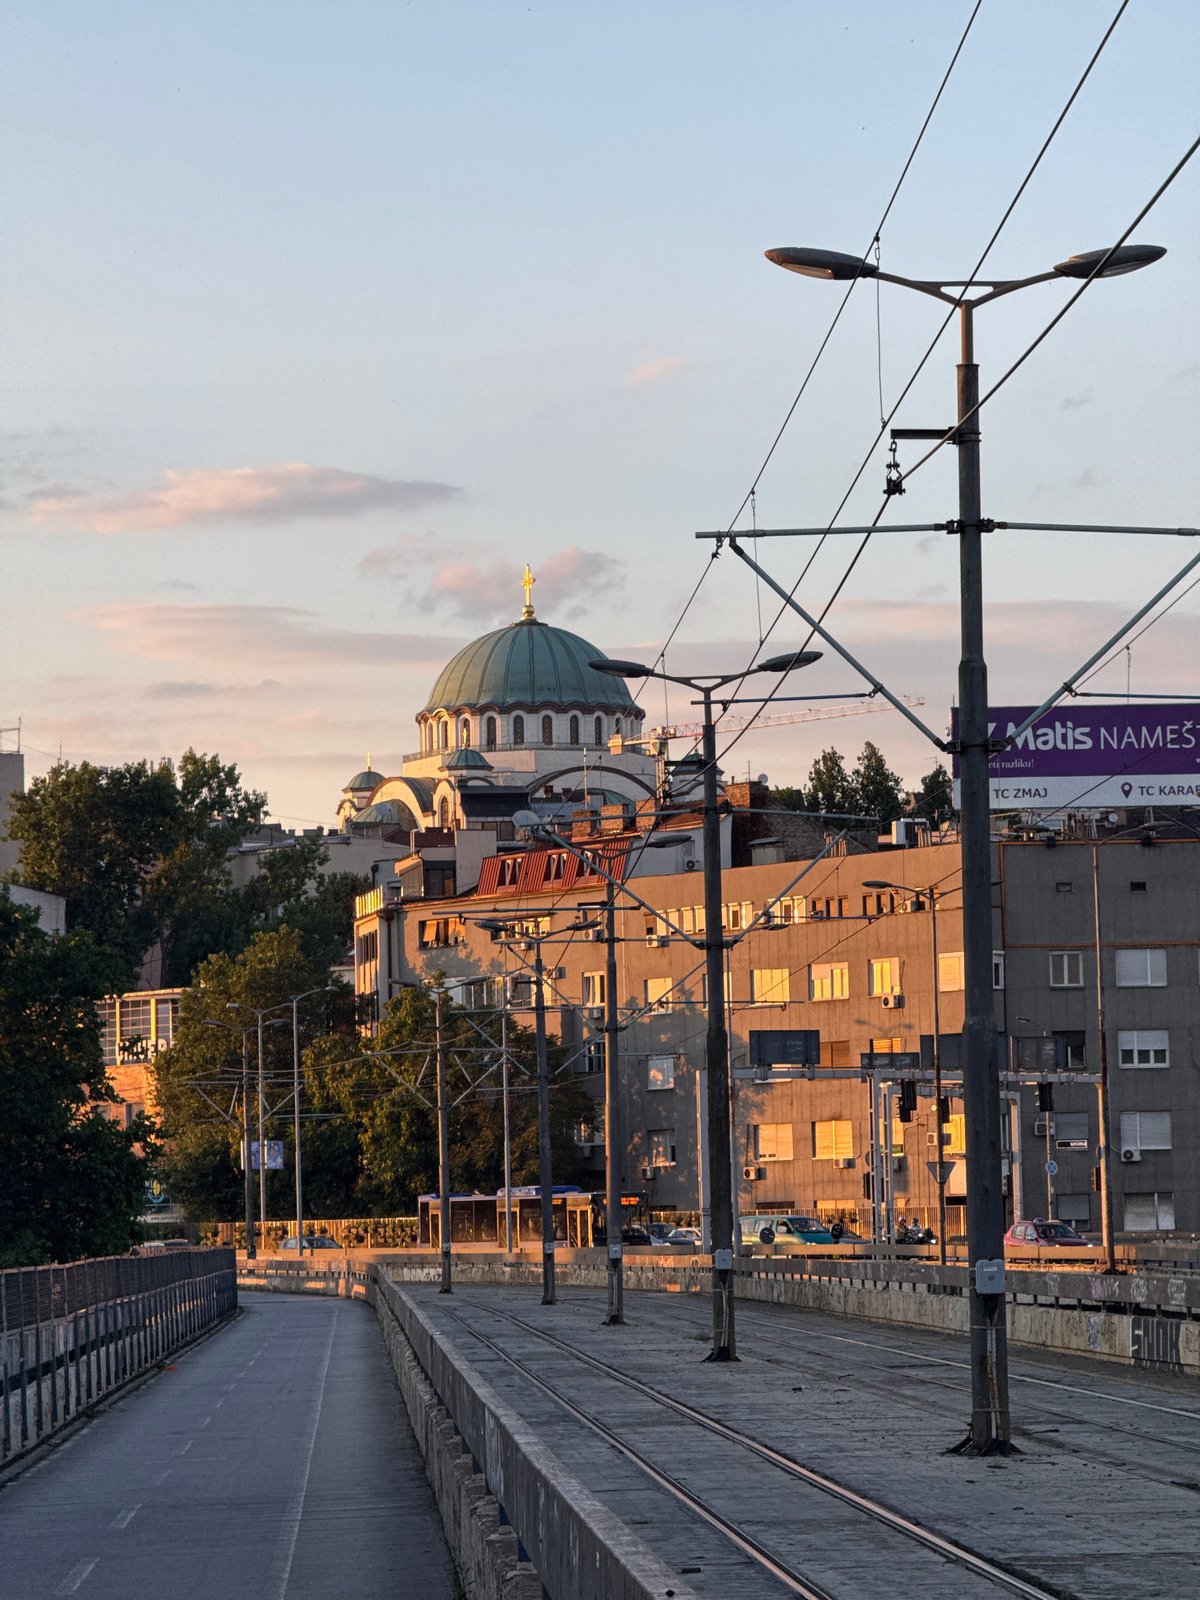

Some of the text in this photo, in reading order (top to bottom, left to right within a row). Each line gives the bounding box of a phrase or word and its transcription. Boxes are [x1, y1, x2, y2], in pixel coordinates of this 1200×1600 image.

[1004, 721, 1094, 751] Matis
[988, 758, 1034, 769] eti razliku!
[993, 787, 1048, 799] TC ZMAJ
[1138, 785, 1155, 796] TC
